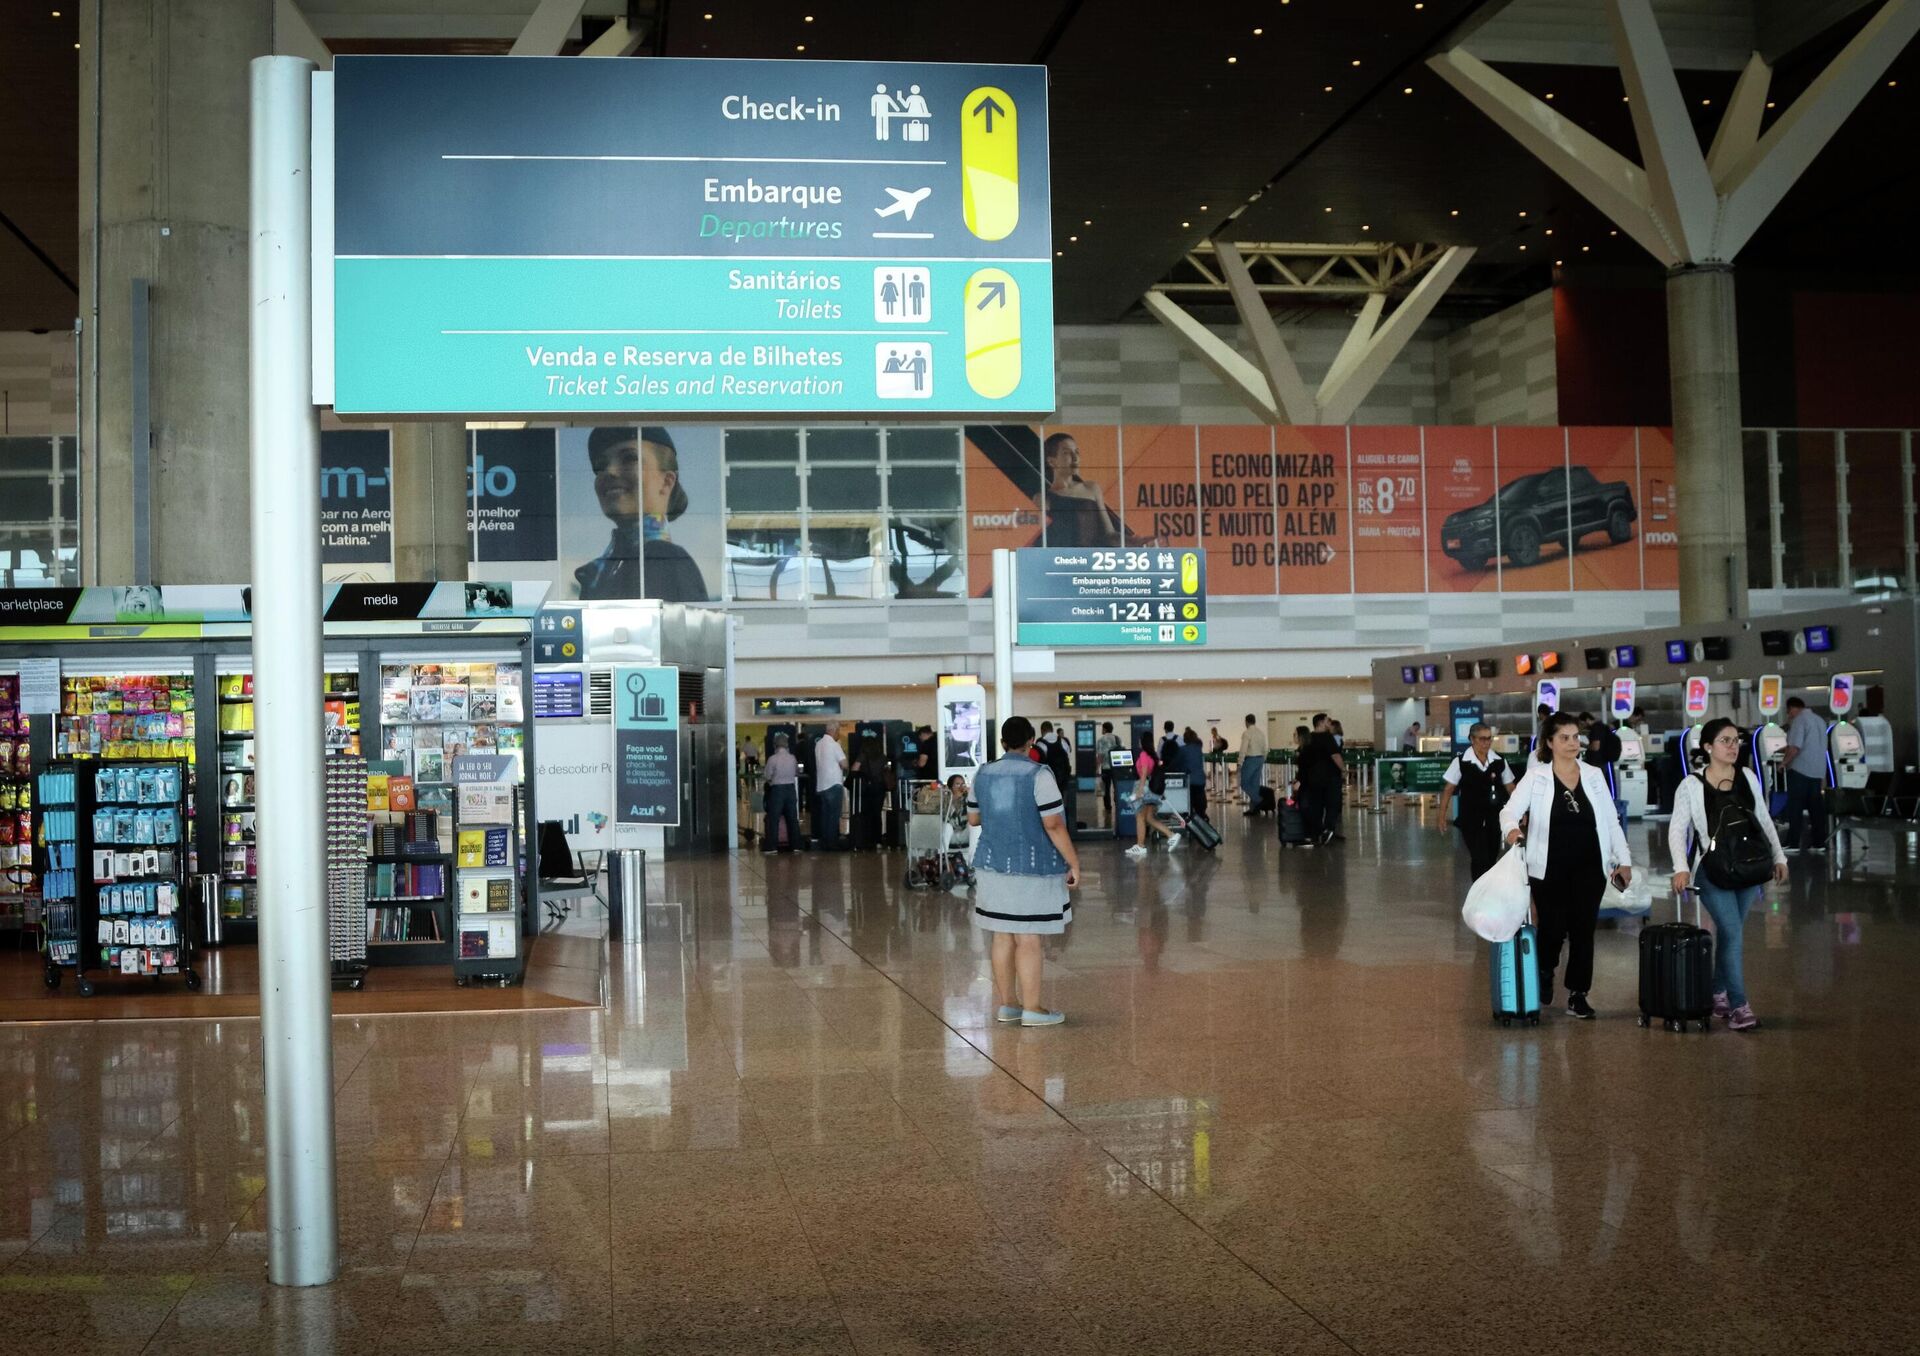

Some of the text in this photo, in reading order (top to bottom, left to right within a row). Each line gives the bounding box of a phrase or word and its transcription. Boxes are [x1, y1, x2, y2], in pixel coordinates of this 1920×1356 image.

[722, 95, 841, 121] Check-in
[704, 178, 842, 209] Embarque
[699, 214, 843, 243] Departures
[728, 270, 842, 291] Sanitários
[775, 298, 842, 319] Toilets
[525, 345, 843, 367] Venda e Reserva de Bilhetes
[545, 375, 844, 397] Ticket Sales and Reservation
[1211, 454, 1335, 478] ECONOMIZAR
[1136, 483, 1235, 508] ALUGANDO
[1243, 483, 1289, 507] PELO
[342, 510, 358, 519] no
[479, 507, 520, 518] melhor
[1358, 496, 1374, 515] R$
[321, 523, 348, 532] com
[351, 523, 359, 532] a
[478, 520, 515, 531] Aérea
[1153, 507, 1337, 537] ISSO É MUITO ALÉM
[1054, 552, 1150, 571] Check-in 25-36
[1232, 542, 1328, 567] DO CARRO
[1072, 576, 1151, 586] Embarque Doméstico
[363, 594, 399, 606] media
[1112, 587, 1152, 595] Departures
[1072, 602, 1152, 621] Check-in 1-24
[1455, 706, 1472, 714] Azul
[626, 744, 664, 754] Faça você
[466, 762, 476, 770] LEU
[476, 762, 481, 770] O
[482, 762, 492, 770] SEU
[548, 762, 597, 775] descobrir
[632, 769, 666, 778] despache
[630, 804, 655, 816] Azul
